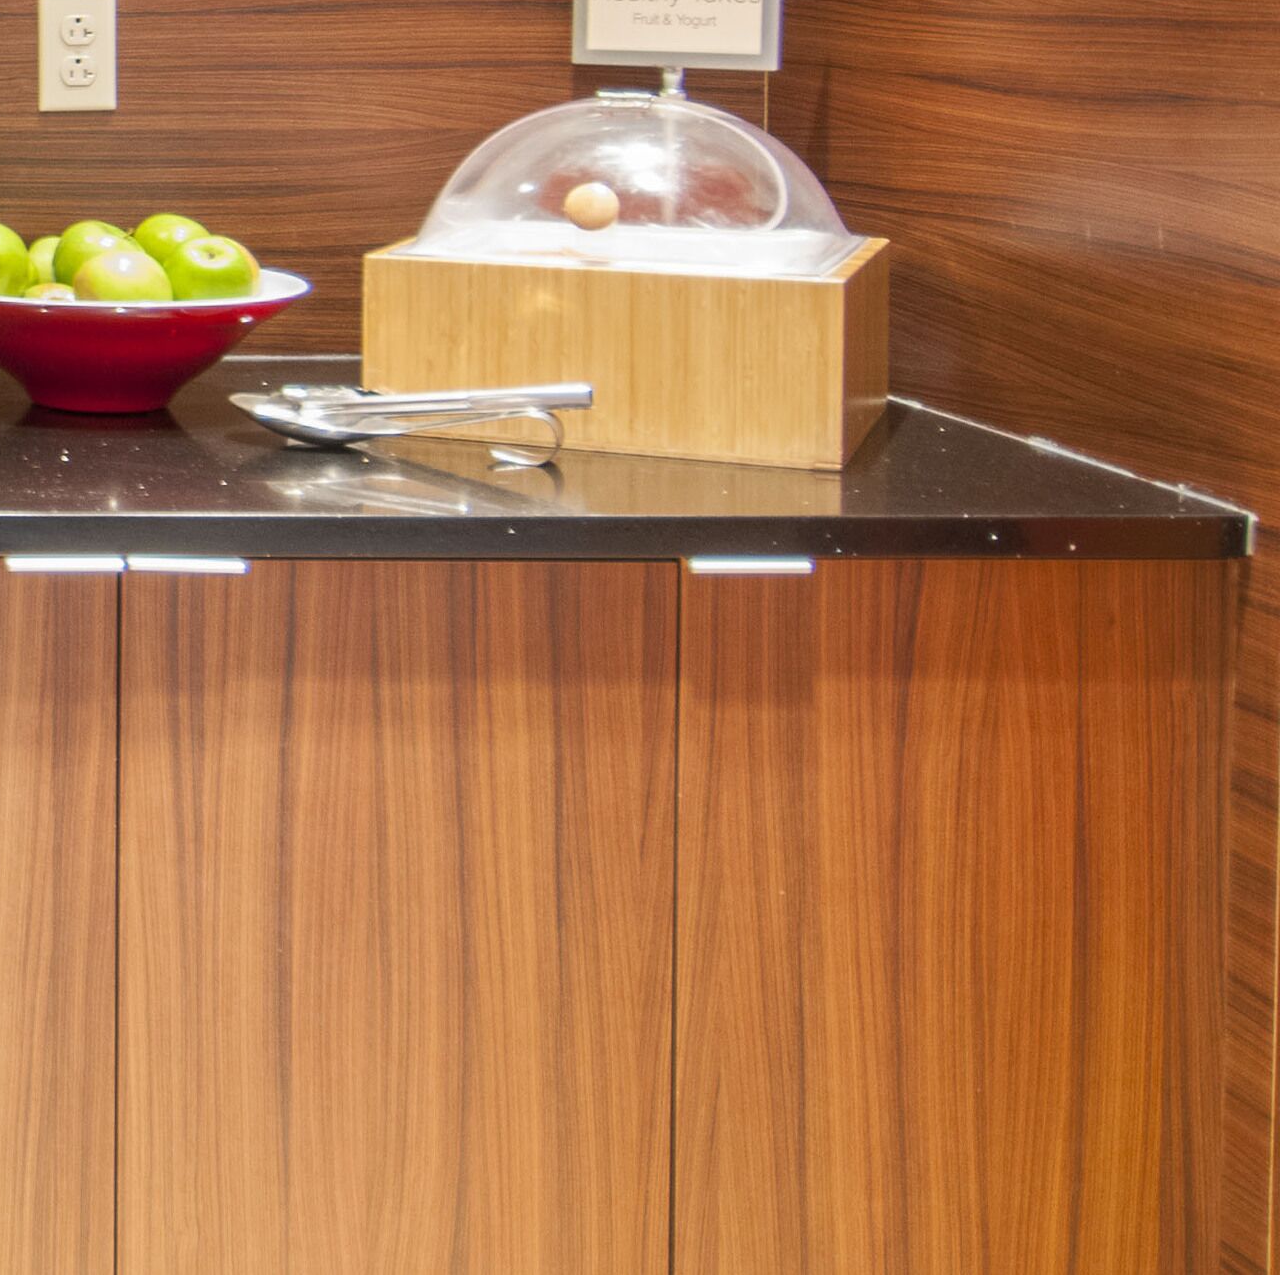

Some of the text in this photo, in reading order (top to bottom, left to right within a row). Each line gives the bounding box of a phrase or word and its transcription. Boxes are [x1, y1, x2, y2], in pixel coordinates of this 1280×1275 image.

[633, 13, 716, 28] Fruit & Yogurt
